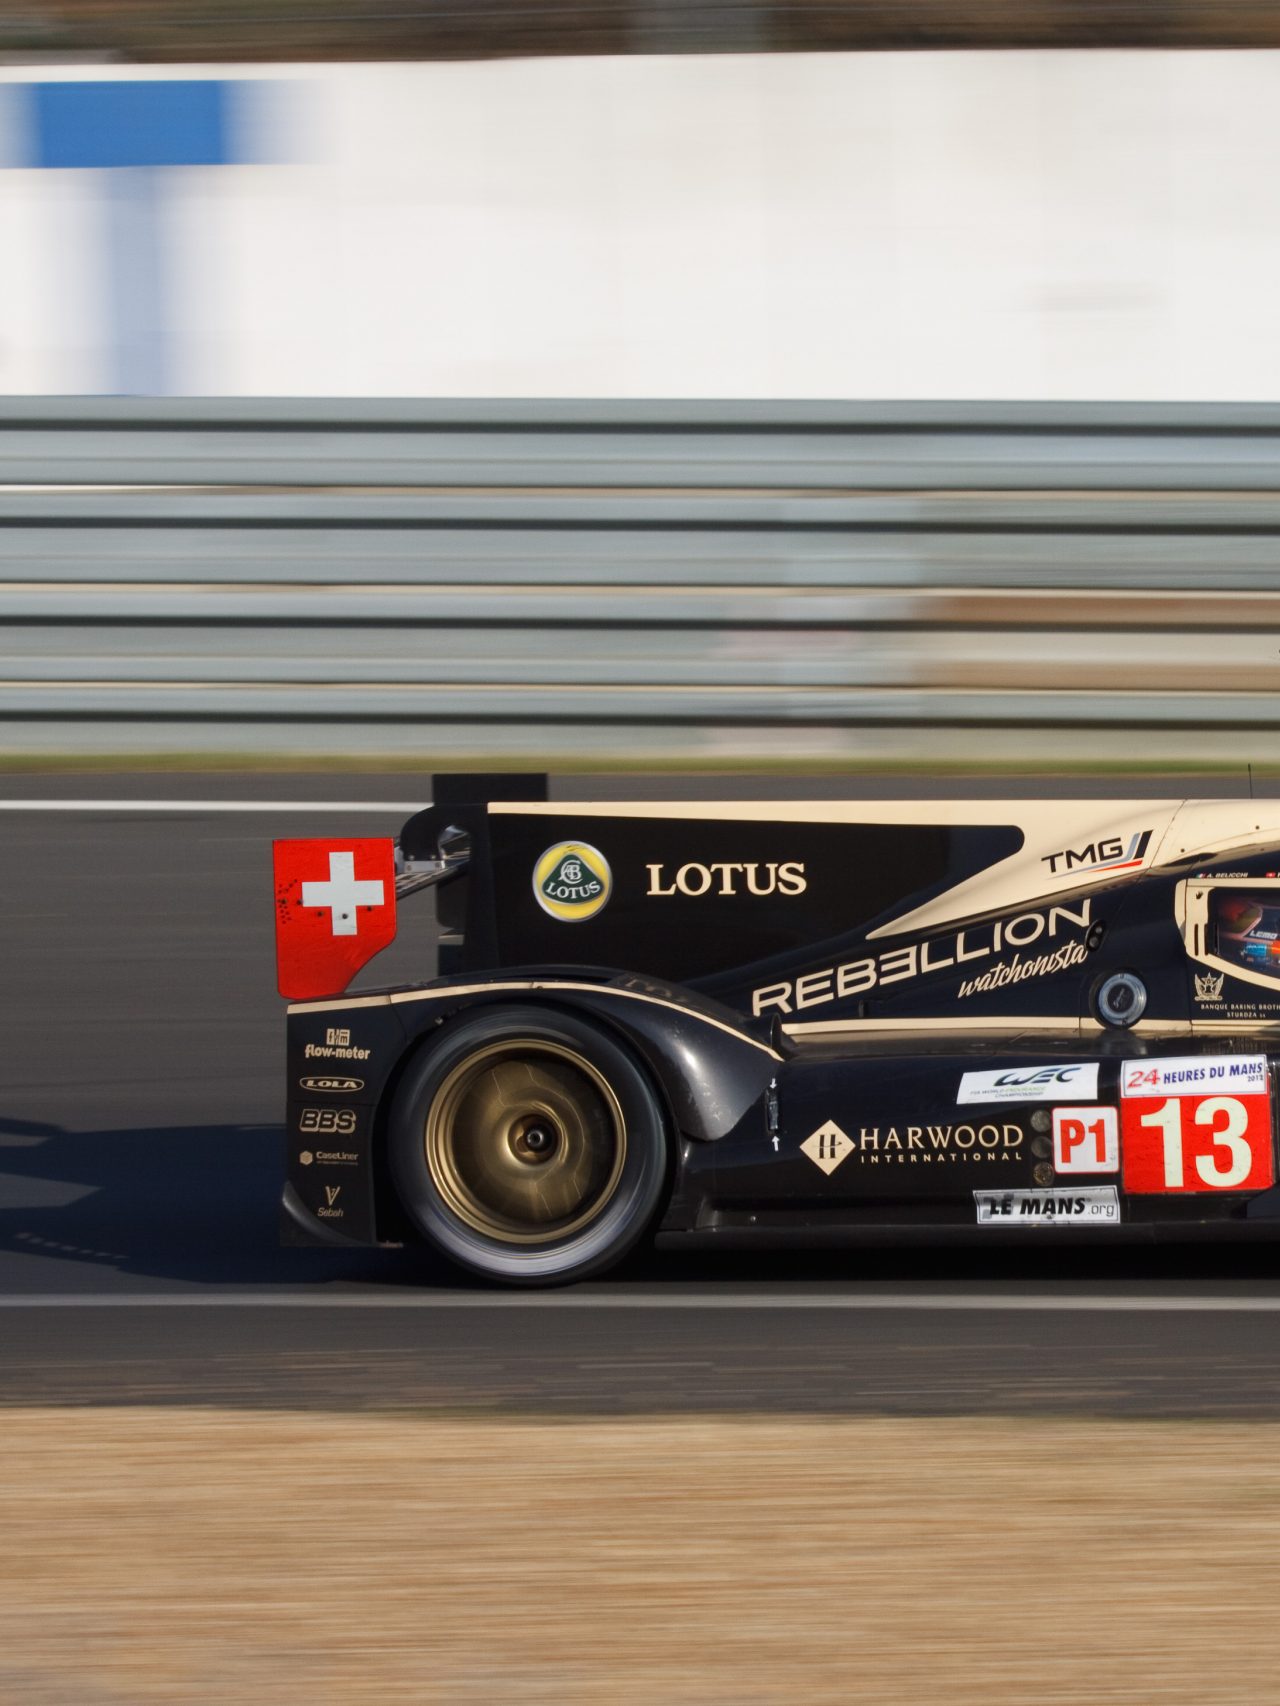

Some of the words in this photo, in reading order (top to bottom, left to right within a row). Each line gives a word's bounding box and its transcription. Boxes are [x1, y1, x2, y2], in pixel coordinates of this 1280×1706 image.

[1041, 837, 1123, 873] TMG
[546, 880, 601, 899] LOTUS
[645, 862, 807, 896] LOTUS
[1249, 930, 1278, 940] LEMO
[957, 939, 1088, 999] watchonista
[305, 1044, 370, 1059] flow-meter
[307, 1080, 358, 1089] LOLA
[993, 1067, 1082, 1087] WEC
[1127, 1068, 1160, 1089] 24
[1164, 1068, 1205, 1085] HEURES
[1210, 1066, 1225, 1078] DU
[1229, 1062, 1263, 1077] MANS
[300, 1109, 357, 1134] BBS
[860, 1125, 1023, 1150] HARWOOD
[1060, 1119, 1106, 1164] P1
[1140, 1097, 1253, 1188] 13
[861, 1151, 1022, 1163] INTERNATIONAL
[990, 1197, 1014, 1215] LE
